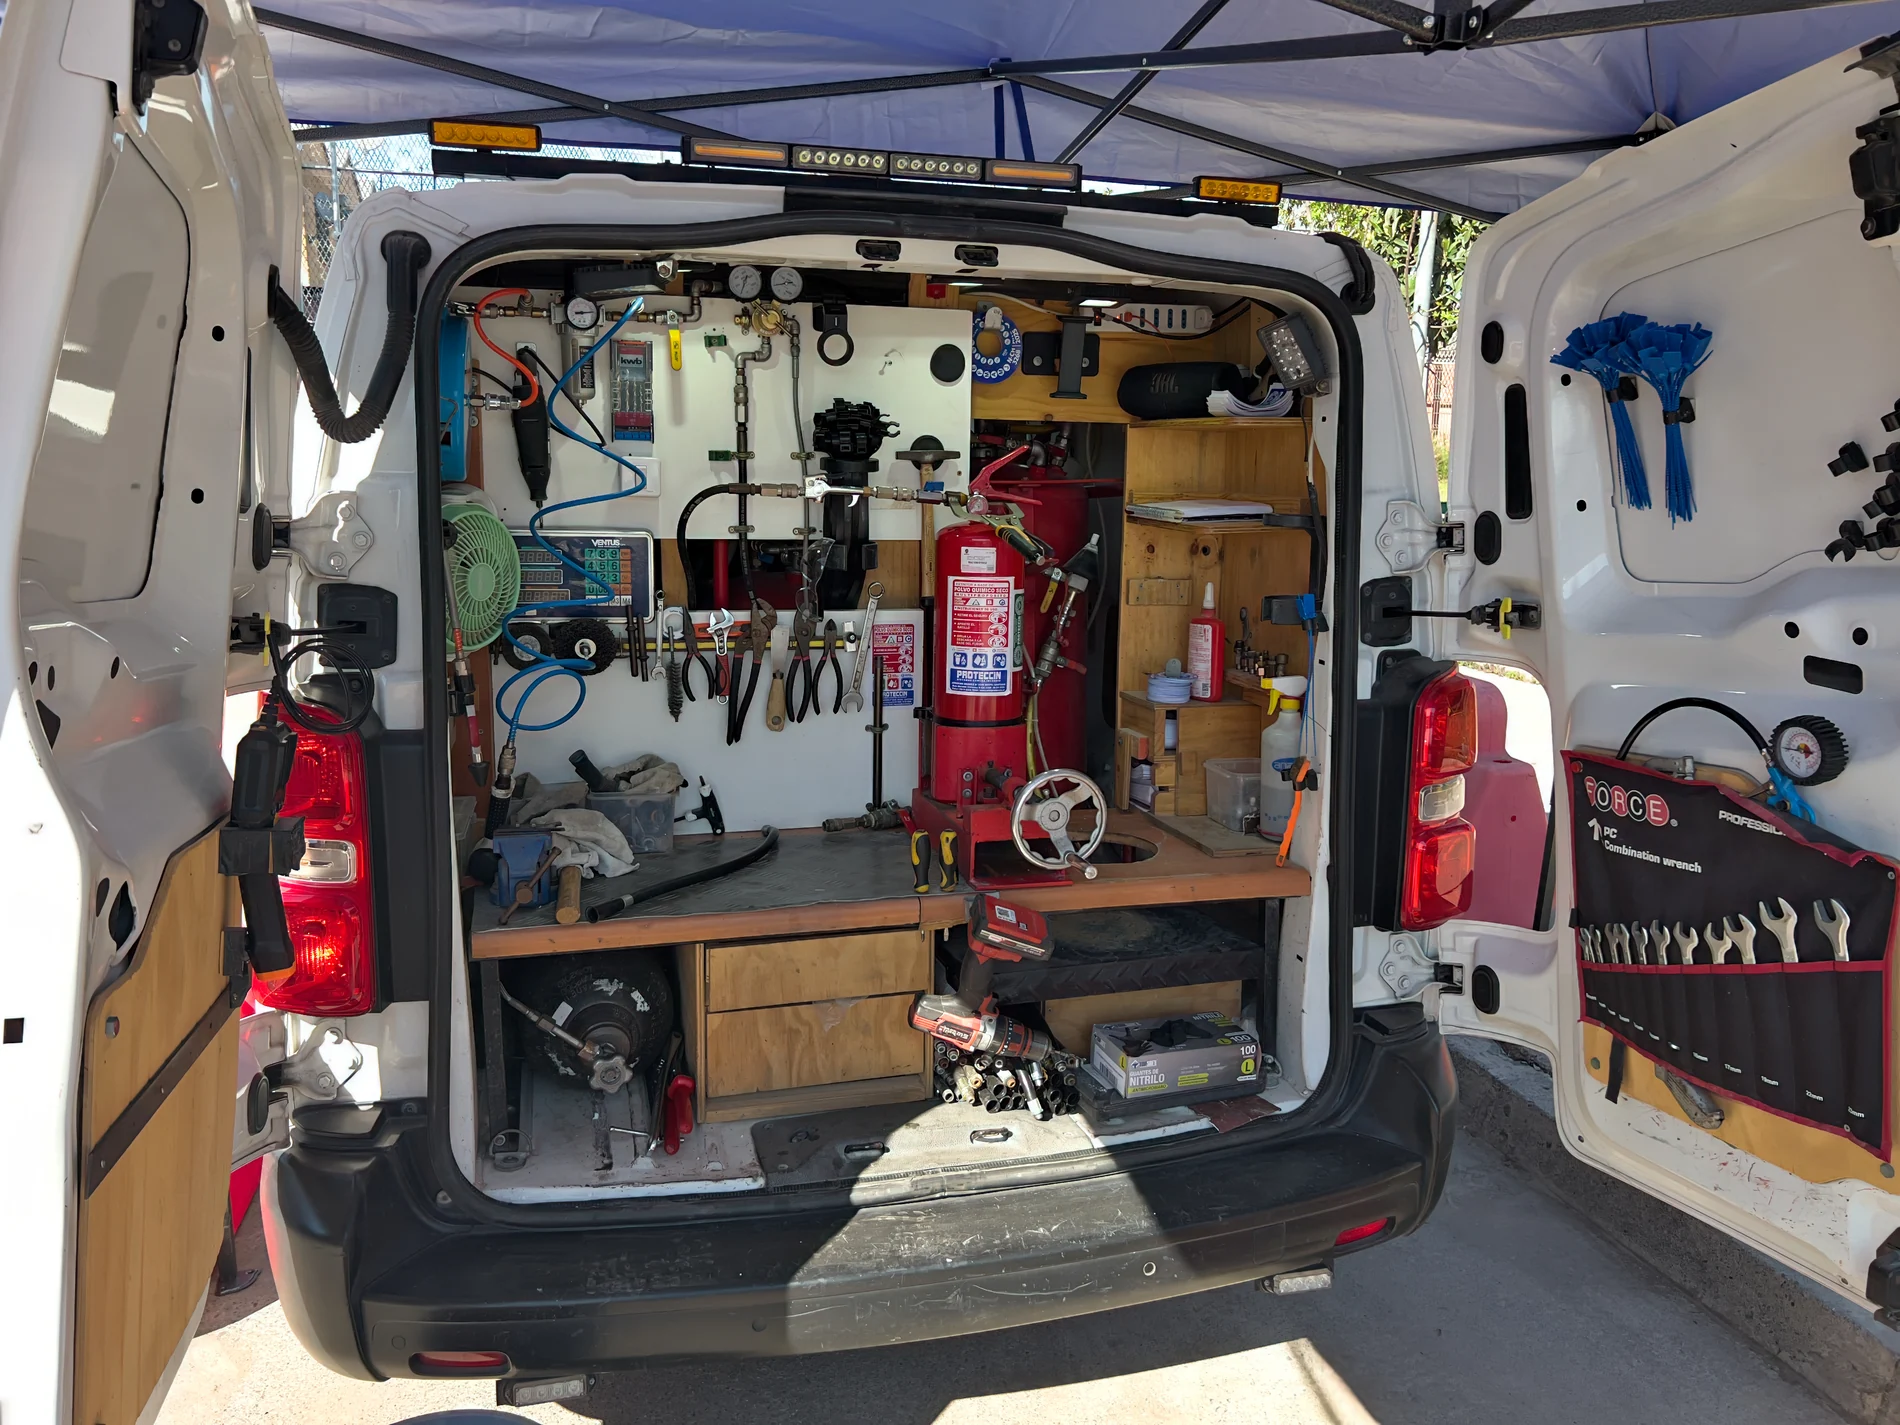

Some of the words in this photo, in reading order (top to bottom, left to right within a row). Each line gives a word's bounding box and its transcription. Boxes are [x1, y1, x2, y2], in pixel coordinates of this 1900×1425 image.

[620, 357, 642, 365] kwb
[1150, 372, 1179, 394] JBL
[591, 539, 621, 547] VENTUS
[587, 550, 594, 559] 7
[599, 550, 606, 559] 8
[611, 550, 618, 559] 9
[587, 562, 594, 570] 4
[600, 562, 606, 570] 5
[611, 562, 618, 570] 6
[600, 574, 606, 582] 2
[612, 574, 618, 582] 3
[588, 586, 595, 594] 0
[956, 670, 1002, 680] PROTECCIN
[1585, 780, 1665, 822] FORCE
[1718, 810, 1786, 836] PROFESSI
[1603, 826, 1618, 839] PC
[1603, 840, 1661, 864] Combination
[1662, 856, 1702, 873] wrench
[1240, 1045, 1256, 1055] 100
[1130, 1073, 1165, 1086] NITRILO
